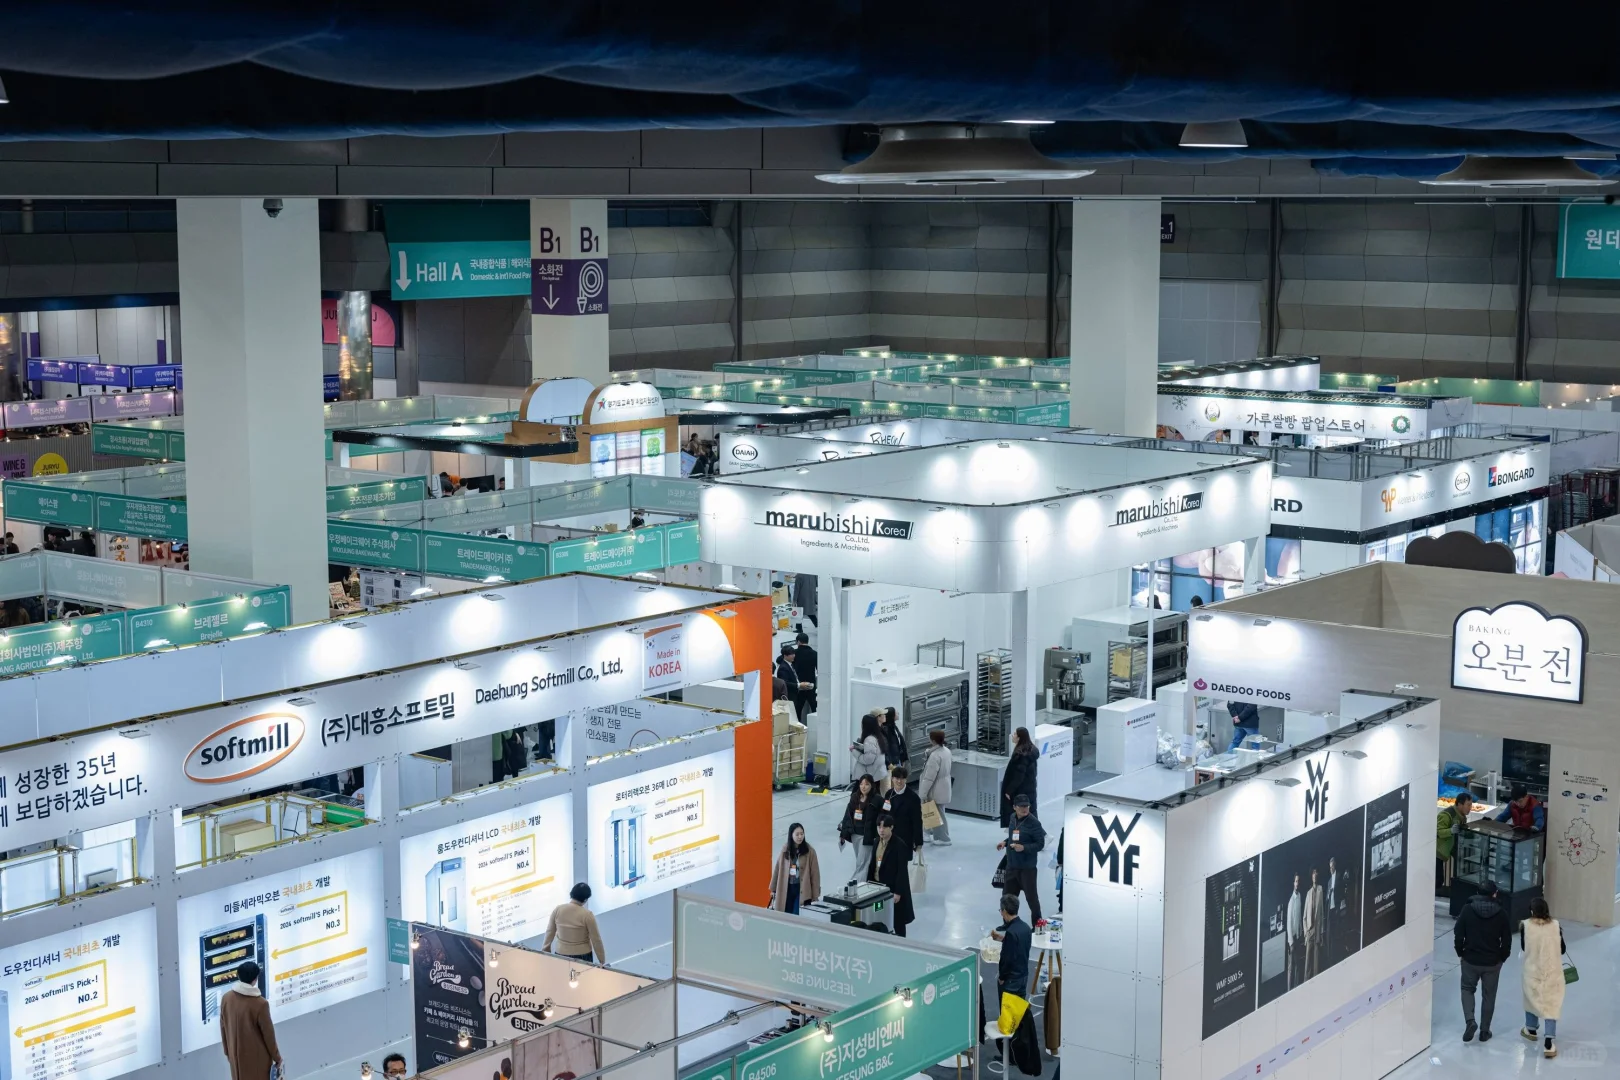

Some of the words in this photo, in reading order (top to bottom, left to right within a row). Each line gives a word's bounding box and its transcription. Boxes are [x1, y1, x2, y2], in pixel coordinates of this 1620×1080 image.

[540, 227, 561, 254] B1
[580, 226, 600, 253] B1
[416, 263, 446, 282] Hall
[452, 262, 463, 281] A
[470, 259, 507, 269] 국내종합식품
[538, 264, 564, 276] 소화전
[471, 273, 495, 281] Domestic
[509, 272, 521, 280] Food
[588, 304, 603, 312] 소화전
[1246, 412, 1298, 430] 가루쌀빵
[1301, 416, 1366, 433] 팝업스토어
[1498, 467, 1535, 486] BONGARD
[1116, 495, 1180, 526] marubishi
[1183, 497, 1200, 510] Korea
[1271, 498, 1303, 513] RD
[766, 510, 870, 535] marubishi
[876, 520, 906, 537] Korea
[371, 538, 397, 551] 주식회사
[801, 539, 833, 549] Ingredients
[840, 543, 870, 552] Machines
[135, 619, 153, 628] B4310
[194, 613, 228, 630] 브레젤르
[1468, 624, 1511, 636] BAKING
[200, 630, 223, 640] Brejelle
[657, 650, 673, 659] Made
[649, 662, 682, 678] KOREA
[475, 679, 528, 704] Daehung
[531, 666, 574, 692] Softmill
[1211, 683, 1253, 696] DAEDOO
[1256, 689, 1291, 701] FOODS
[320, 692, 455, 747] (주)대흥소프트밀
[620, 706, 641, 719] 만드는
[590, 716, 604, 727] 생지
[607, 718, 622, 729] 전문
[201, 722, 289, 766] softmill
[14, 763, 70, 795] 성장한
[77, 752, 117, 779] 35년
[651, 780, 665, 792] 36매
[666, 777, 678, 788] LCD
[679, 771, 701, 784] 국내최초
[702, 767, 714, 777] 개발
[16, 775, 148, 822] 보답하겠습니다.
[437, 831, 485, 855] 룸도우컨디셔너
[486, 828, 499, 840] LCD
[501, 819, 527, 835] 국내최초
[528, 815, 542, 827] 개발
[516, 860, 530, 870] NO.4
[224, 891, 280, 914] 미들세라믹오븐
[282, 880, 313, 897] 국내최초
[315, 876, 331, 888] 개발
[280, 920, 292, 930] 2024
[325, 919, 341, 931] NO.3
[3, 951, 61, 977] 도우컨디셔너
[63, 940, 100, 959] 국내최초
[103, 934, 121, 948] 개발
[433, 960, 455, 972] Bread
[429, 969, 455, 985] Garden
[497, 977, 536, 999] Bread
[25, 995, 39, 1005] 2024
[78, 992, 98, 1004] NO.2
[489, 993, 537, 1020] Garden
[820, 1016, 905, 1078] (주)지성비엔씨
[875, 1053, 894, 1071] B&C
